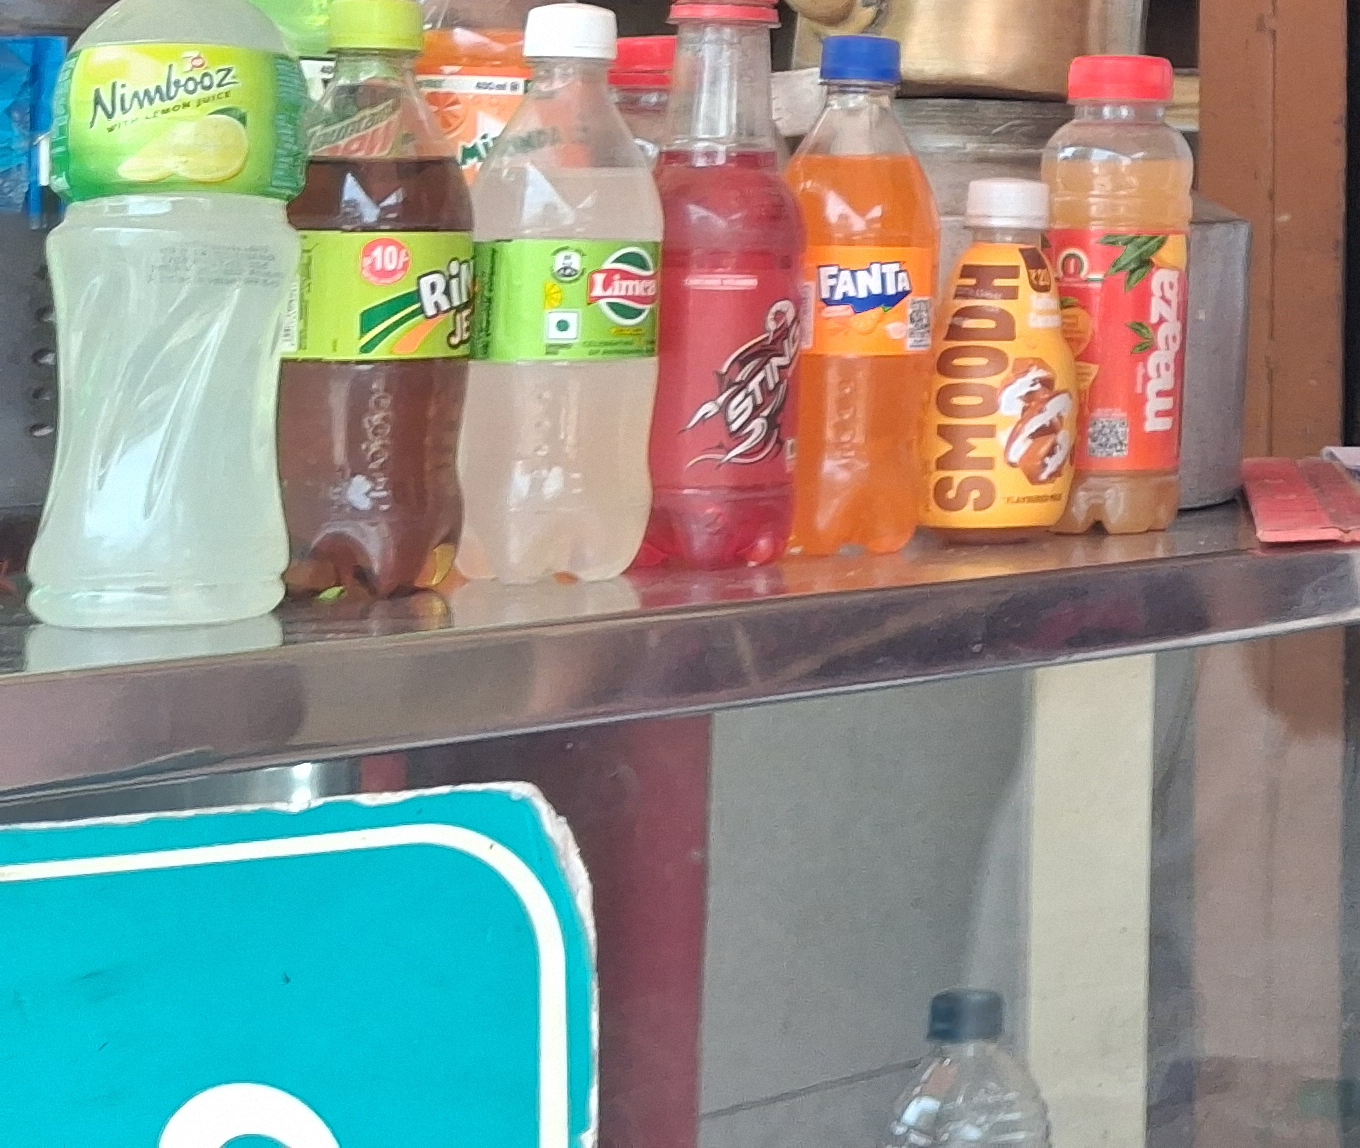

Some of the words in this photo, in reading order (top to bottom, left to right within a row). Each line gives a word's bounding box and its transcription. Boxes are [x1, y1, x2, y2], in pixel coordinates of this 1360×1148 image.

[90, 63, 239, 129] Nimbooz
[145, 101, 191, 121] LEMON
[196, 89, 232, 108] JUICE
[818, 262, 911, 301] FANTA
[1144, 267, 1182, 433] maaza
[933, 264, 1021, 512] SMOODH
